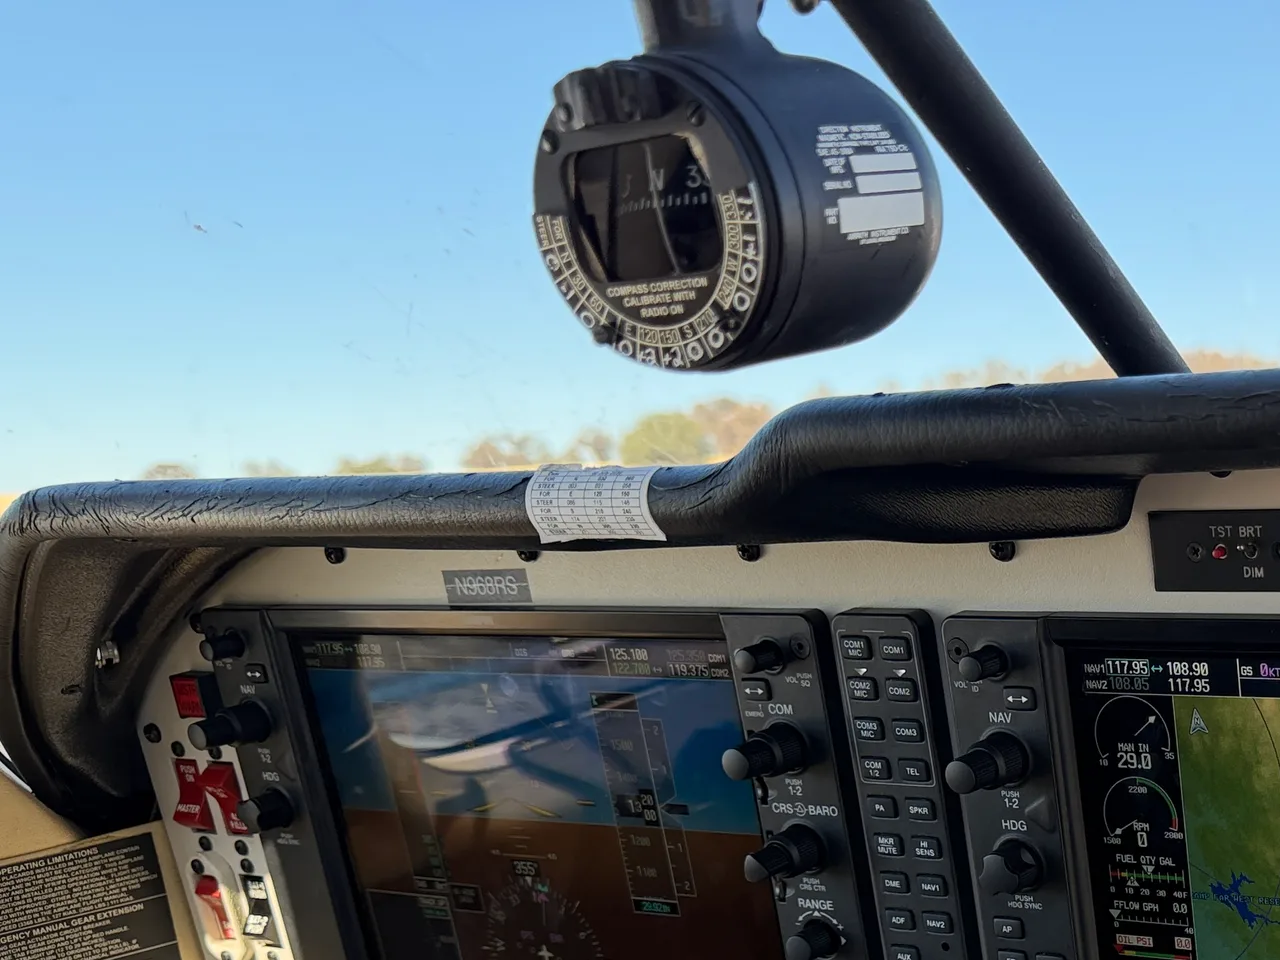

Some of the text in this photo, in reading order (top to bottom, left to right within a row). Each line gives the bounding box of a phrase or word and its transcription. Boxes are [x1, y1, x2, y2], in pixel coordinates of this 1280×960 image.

[536, 215, 550, 247] STEER
[552, 219, 563, 240] FOR
[606, 276, 708, 297] COMPASS CORRECTION
[622, 290, 696, 307] CALIBRATE WITH
[640, 307, 669, 318] RADIO
[1209, 526, 1262, 538] TST BRT
[1243, 567, 1264, 578] DIM
[456, 576, 518, 595] N968RS
[883, 645, 904, 654] COM1
[1107, 661, 1208, 676] 117.95 108.90
[1241, 666, 1253, 676] GS
[1086, 678, 1210, 692] NAV2 117.95
[889, 687, 910, 696] COM2
[768, 704, 793, 715] COM
[989, 712, 1011, 723] NAV
[895, 727, 917, 736] COM3
[1117, 753, 1151, 769] 29.0
[909, 806, 929, 815] SPKR
[1002, 820, 1027, 831] HDG
[47, 847, 99, 865] LIMITATIONS
[1116, 854, 1137, 864] FUEL
